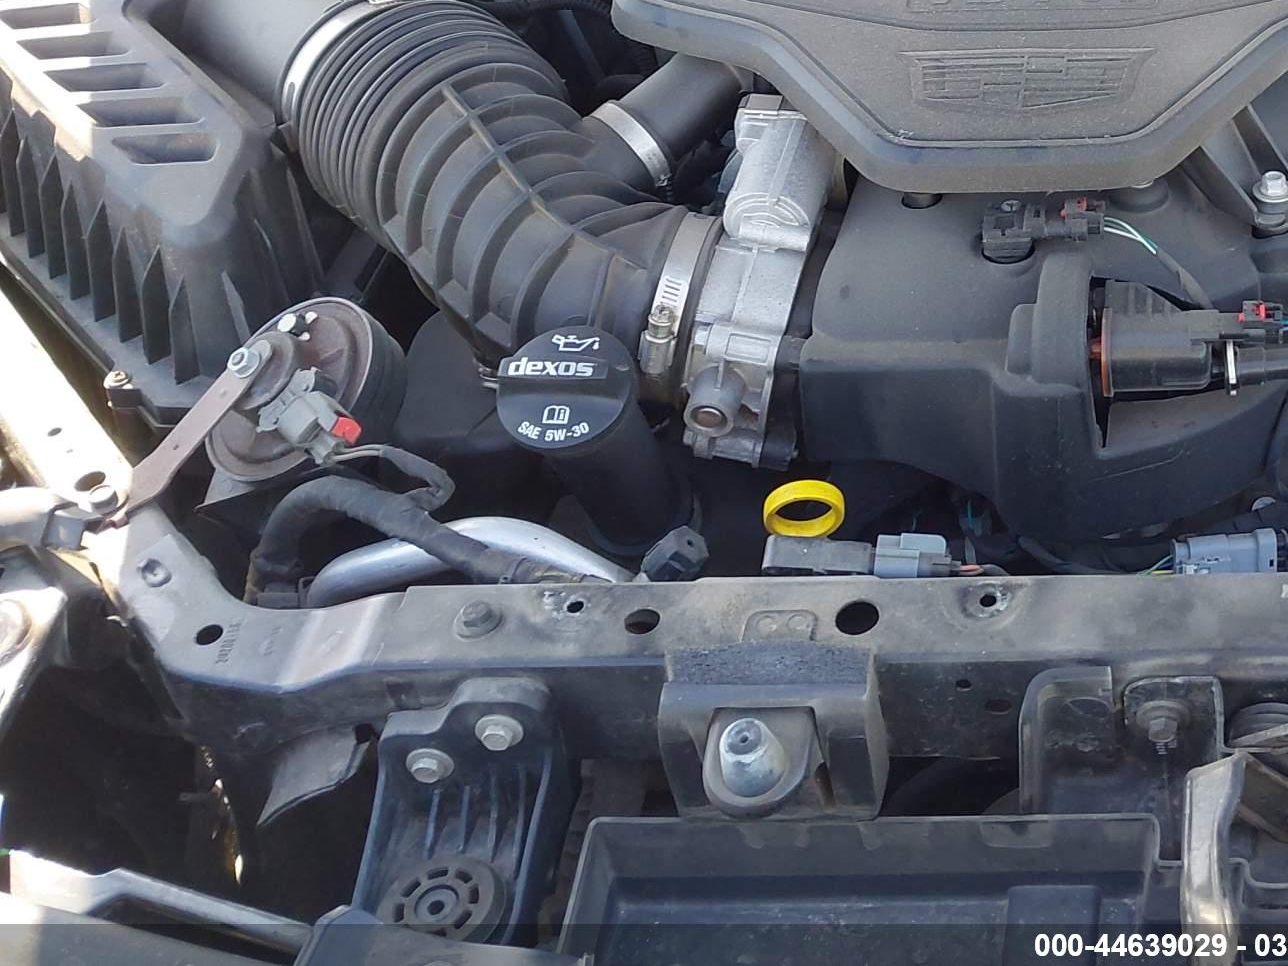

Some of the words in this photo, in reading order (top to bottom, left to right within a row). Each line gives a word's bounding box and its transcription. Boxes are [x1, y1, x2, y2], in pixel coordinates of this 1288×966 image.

[507, 357, 594, 377] dexos
[517, 421, 542, 440] SAE
[544, 422, 590, 442] 5W-30
